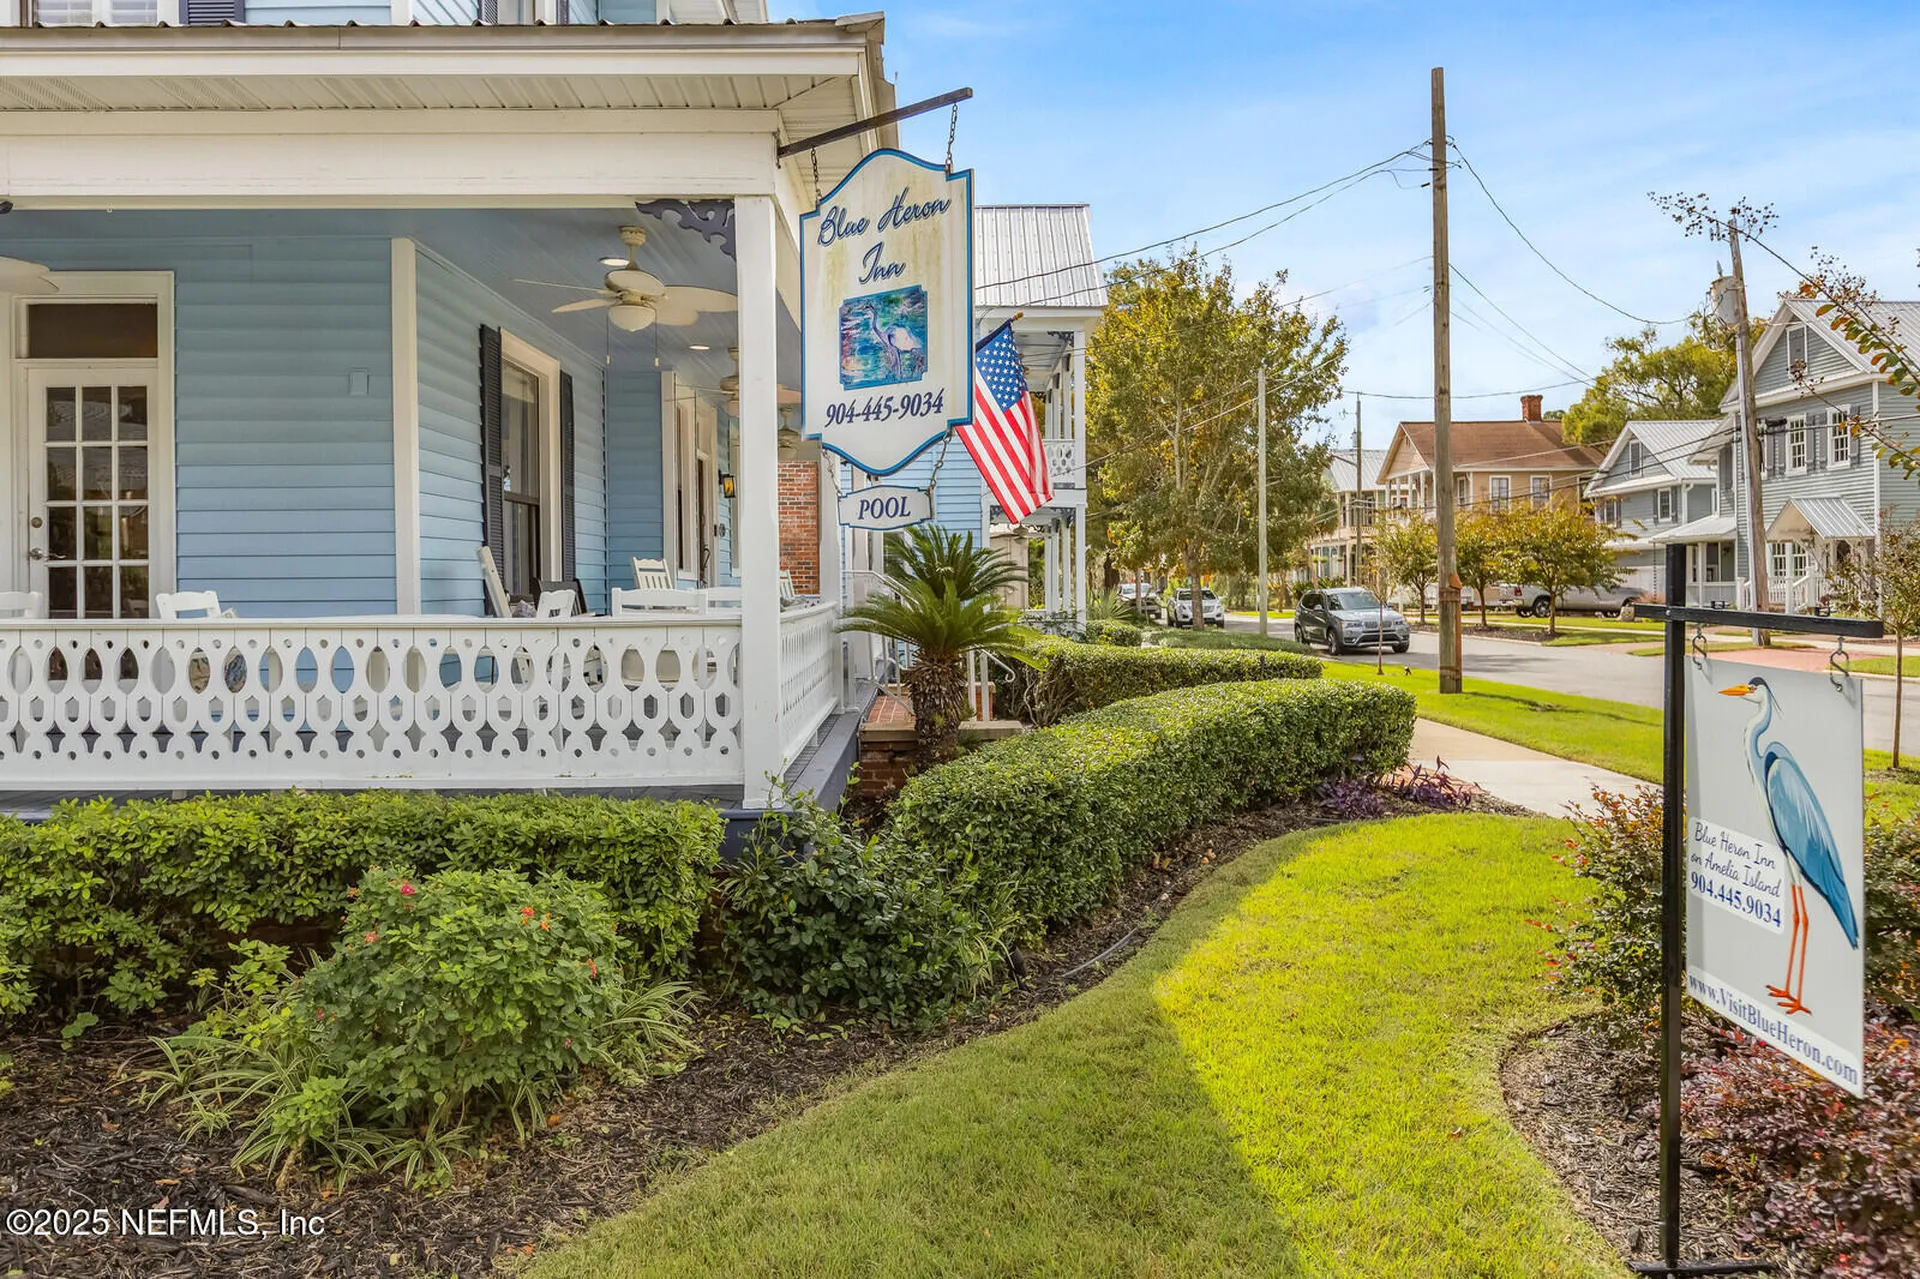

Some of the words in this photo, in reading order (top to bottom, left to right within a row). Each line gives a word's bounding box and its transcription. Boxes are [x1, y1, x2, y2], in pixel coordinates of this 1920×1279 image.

[817, 205, 870, 247] Blue
[877, 186, 951, 232] Heron
[858, 241, 906, 284] Inn
[824, 388, 945, 428] 904-445-9034
[858, 496, 911, 520] POOL
[1695, 822, 1717, 847] Blue
[1720, 831, 1750, 859] Heron
[1753, 843, 1775, 869] Inn
[1690, 853, 1702, 866] on
[1704, 852, 1739, 881] Amelia
[1742, 865, 1781, 897] Island
[1691, 871, 1781, 928] 904.445.9034
[1688, 974, 1858, 1086] www.VisitBlueHeron.com
